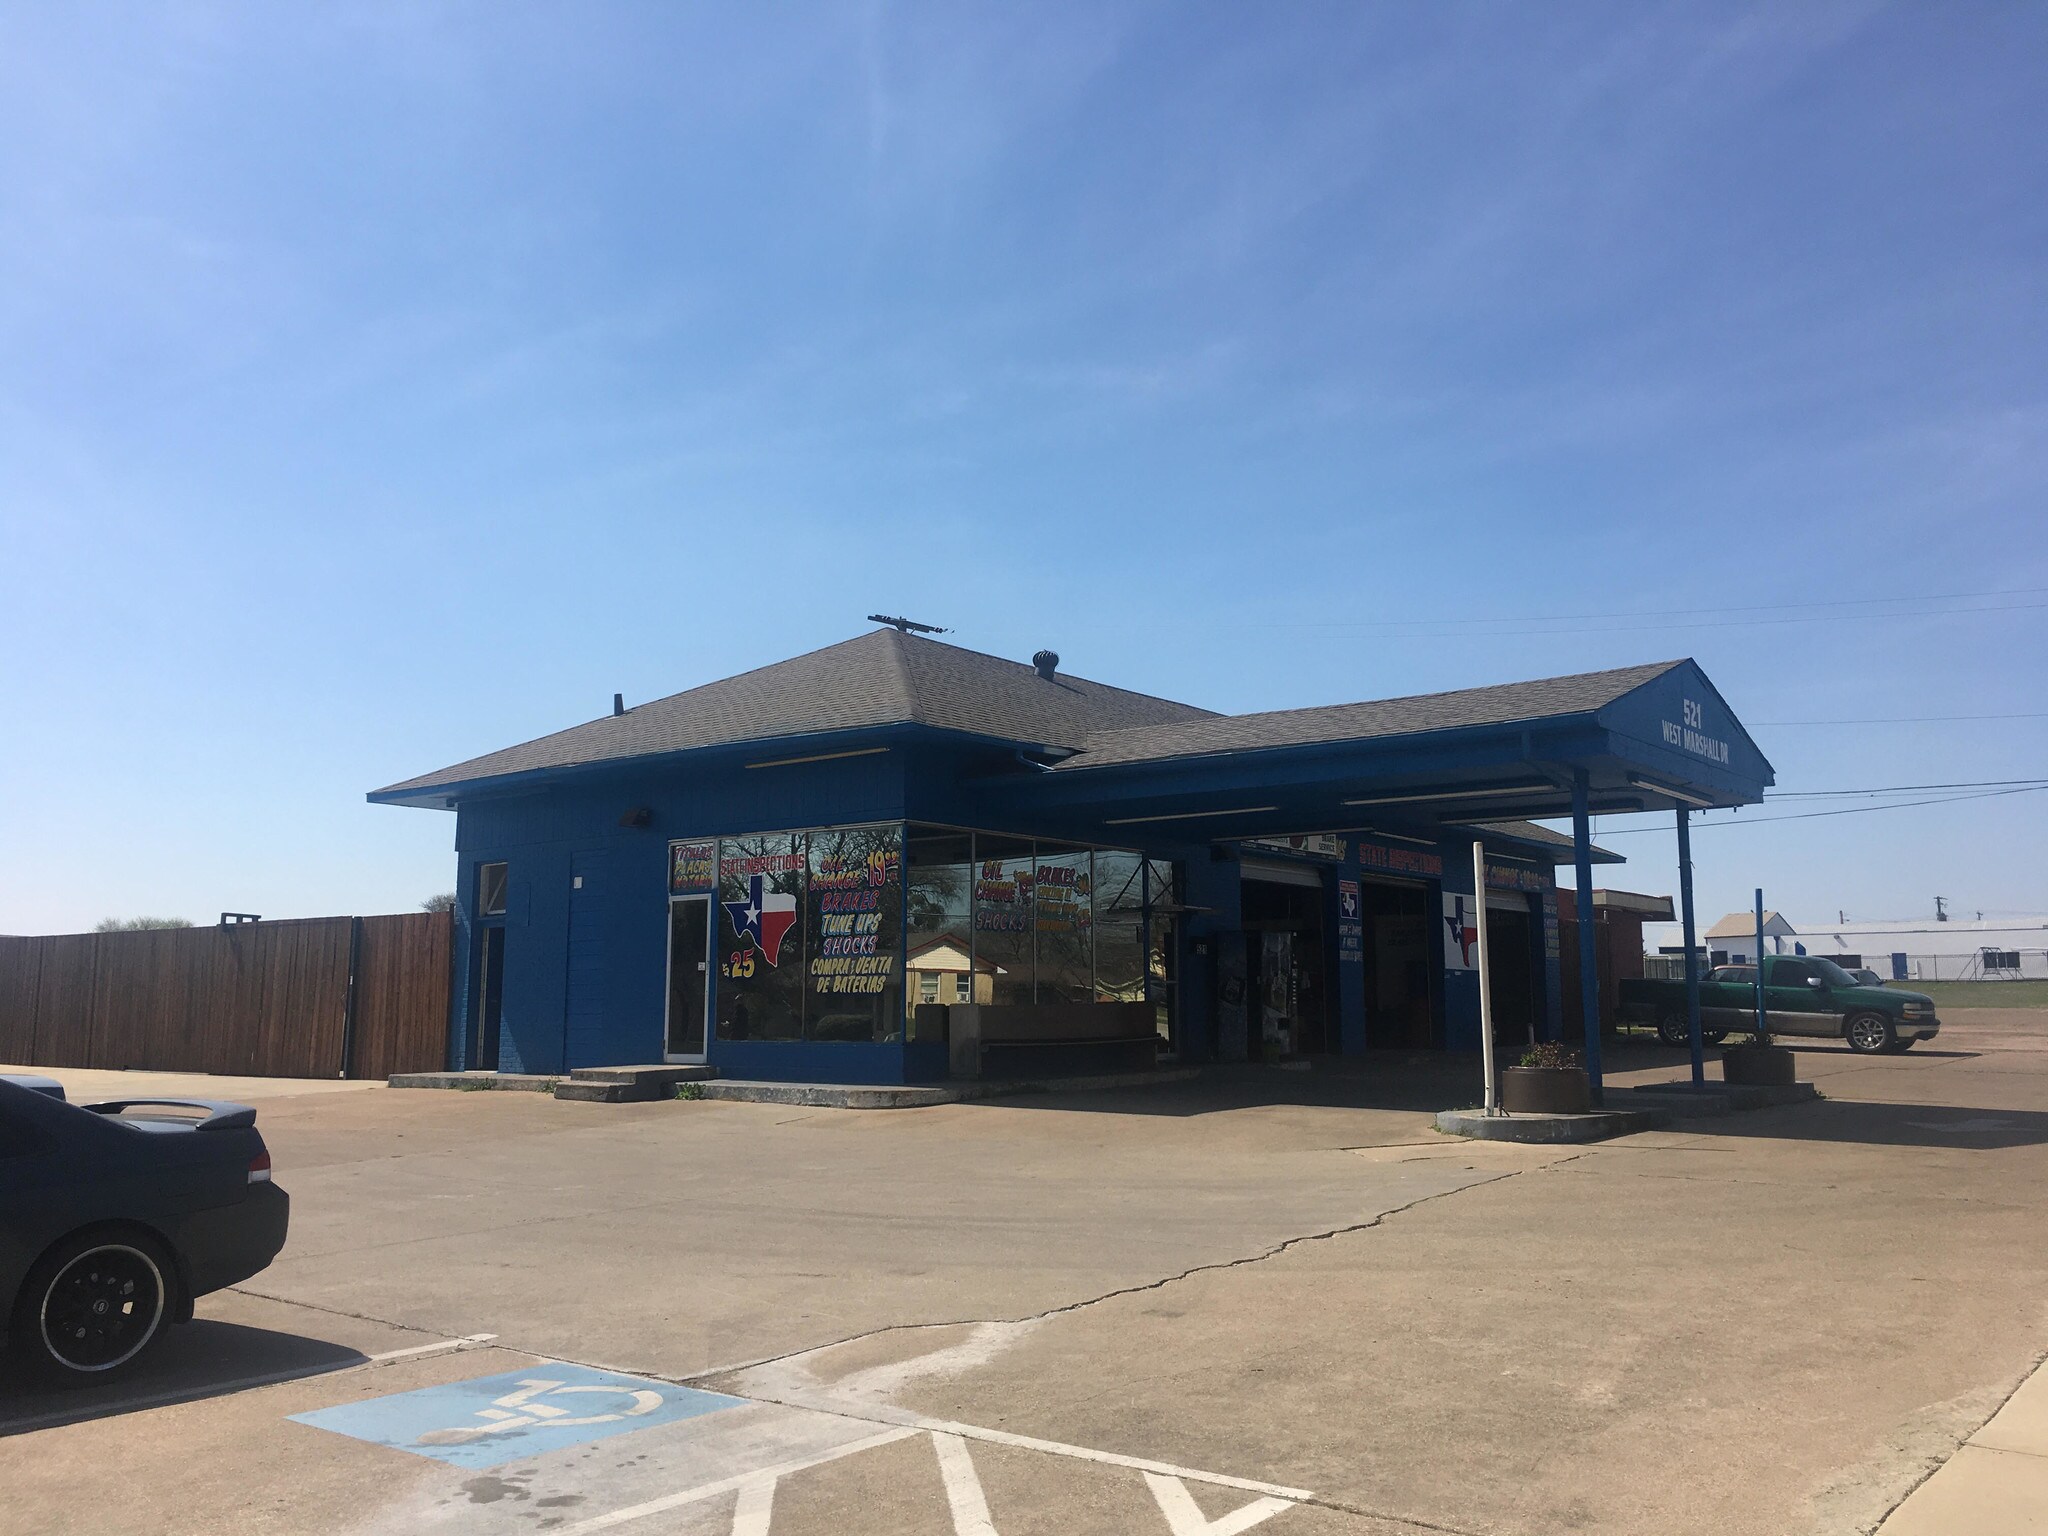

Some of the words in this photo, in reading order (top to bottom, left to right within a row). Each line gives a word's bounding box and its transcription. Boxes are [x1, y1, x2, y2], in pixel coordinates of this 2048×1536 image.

[1683, 698, 1702, 729] 521
[1661, 719, 1682, 747] WEST
[1683, 728, 1721, 762] MARSHALL
[1720, 741, 1729, 765] DR
[1318, 842, 1335, 853] SERVICE
[674, 860, 713, 875] PLACAS
[719, 858, 744, 877] STATE
[746, 853, 805, 876] INSPECTIONS
[822, 854, 846, 873] OIL
[982, 859, 1004, 880] OIL
[1359, 842, 1387, 868] STATE
[1388, 847, 1443, 876] INSPECTIONS
[809, 870, 861, 892] CHANGE
[1036, 864, 1076, 887] BRAKES
[821, 890, 880, 913] BRAKES
[975, 879, 1017, 903] CHANGE
[821, 914, 855, 937] TUNE
[855, 912, 883, 935] UPS
[976, 910, 1027, 931] SHOCKS
[822, 935, 879, 956] SHOCKS
[810, 957, 850, 976] COMPRA
[855, 956, 893, 974] VENTA
[816, 976, 831, 993] DE
[832, 975, 887, 994] BATERIAS
